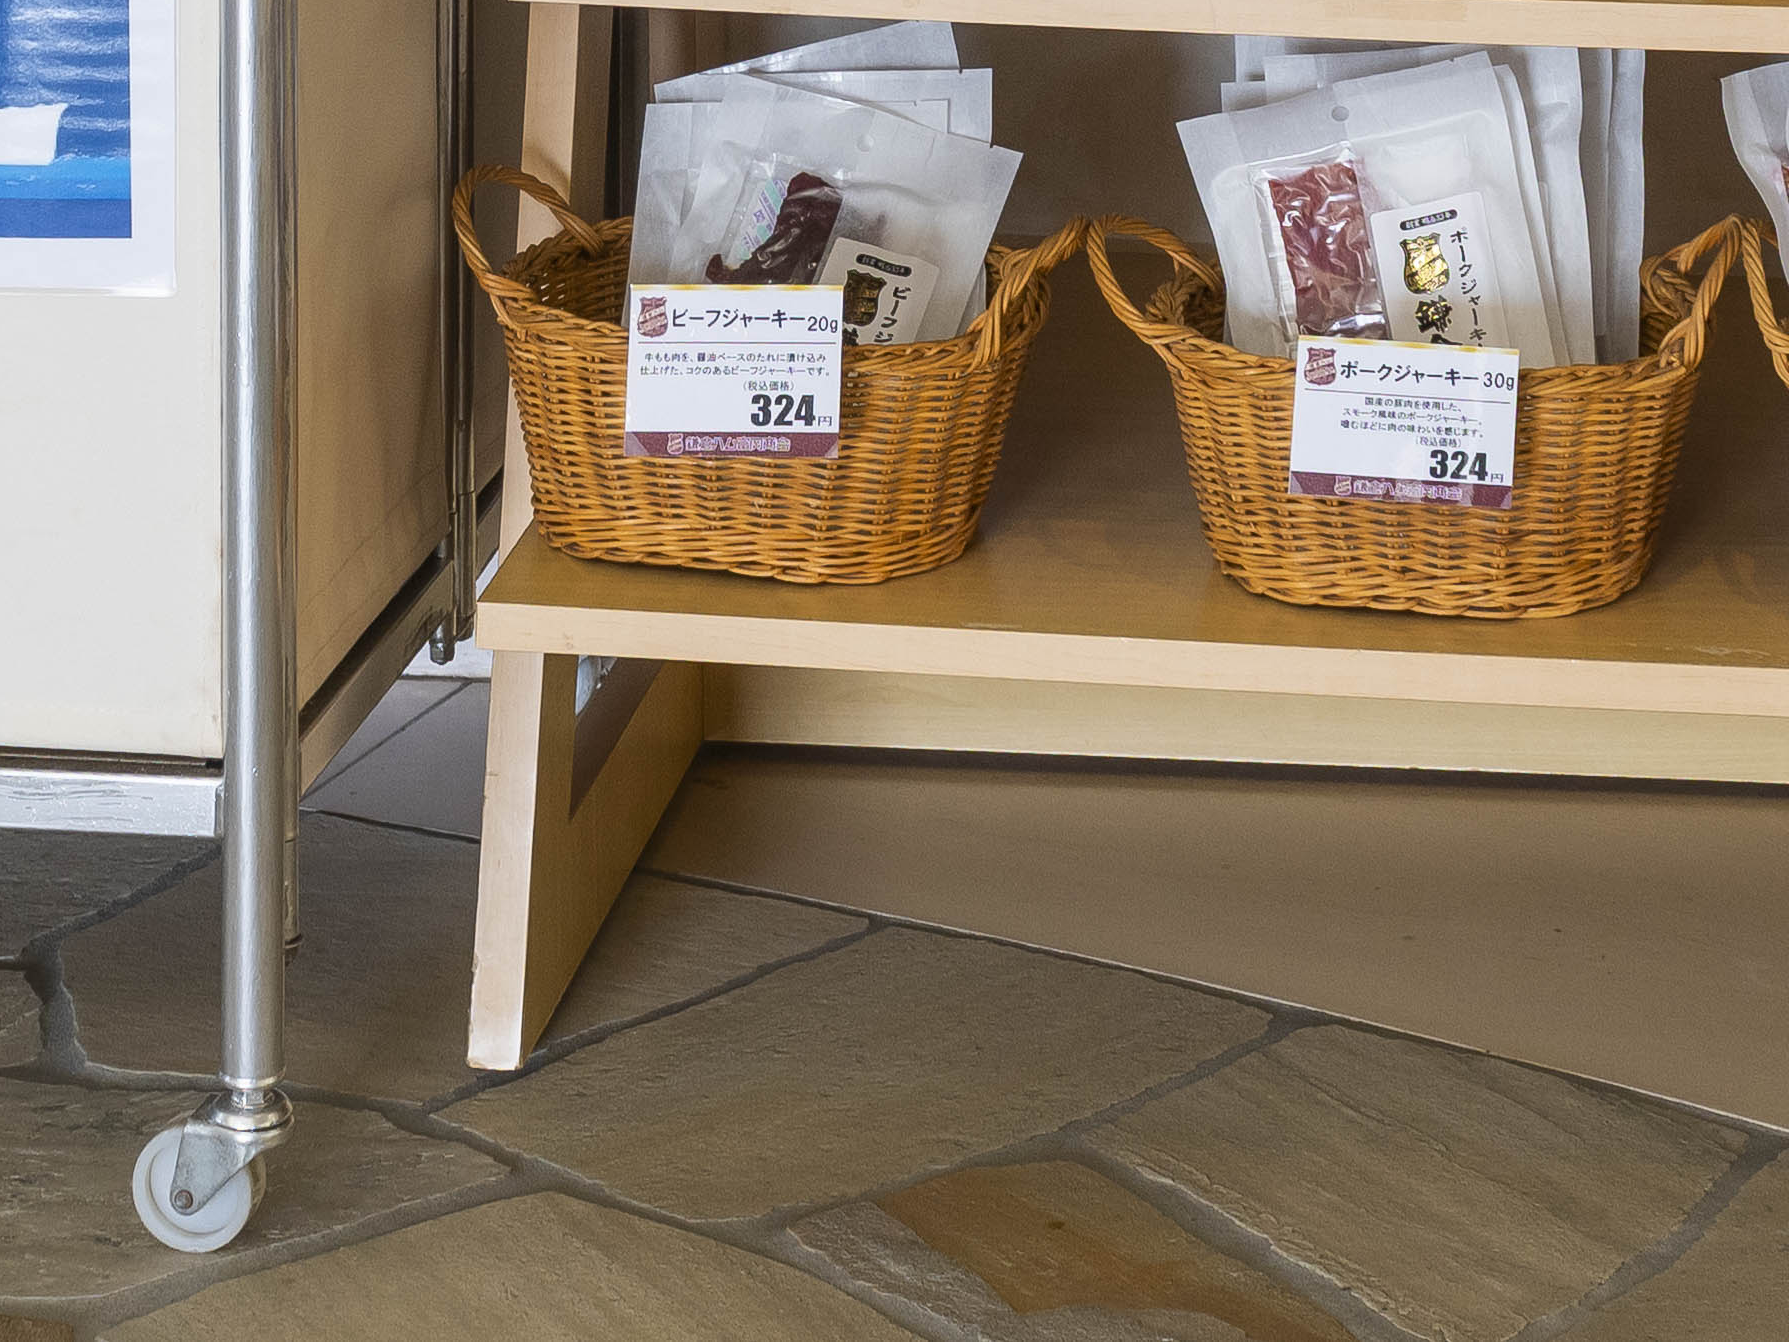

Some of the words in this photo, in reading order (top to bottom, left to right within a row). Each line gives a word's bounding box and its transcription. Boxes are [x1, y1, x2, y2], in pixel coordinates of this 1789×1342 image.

[1340, 363, 1479, 387] ポークジャーキー
